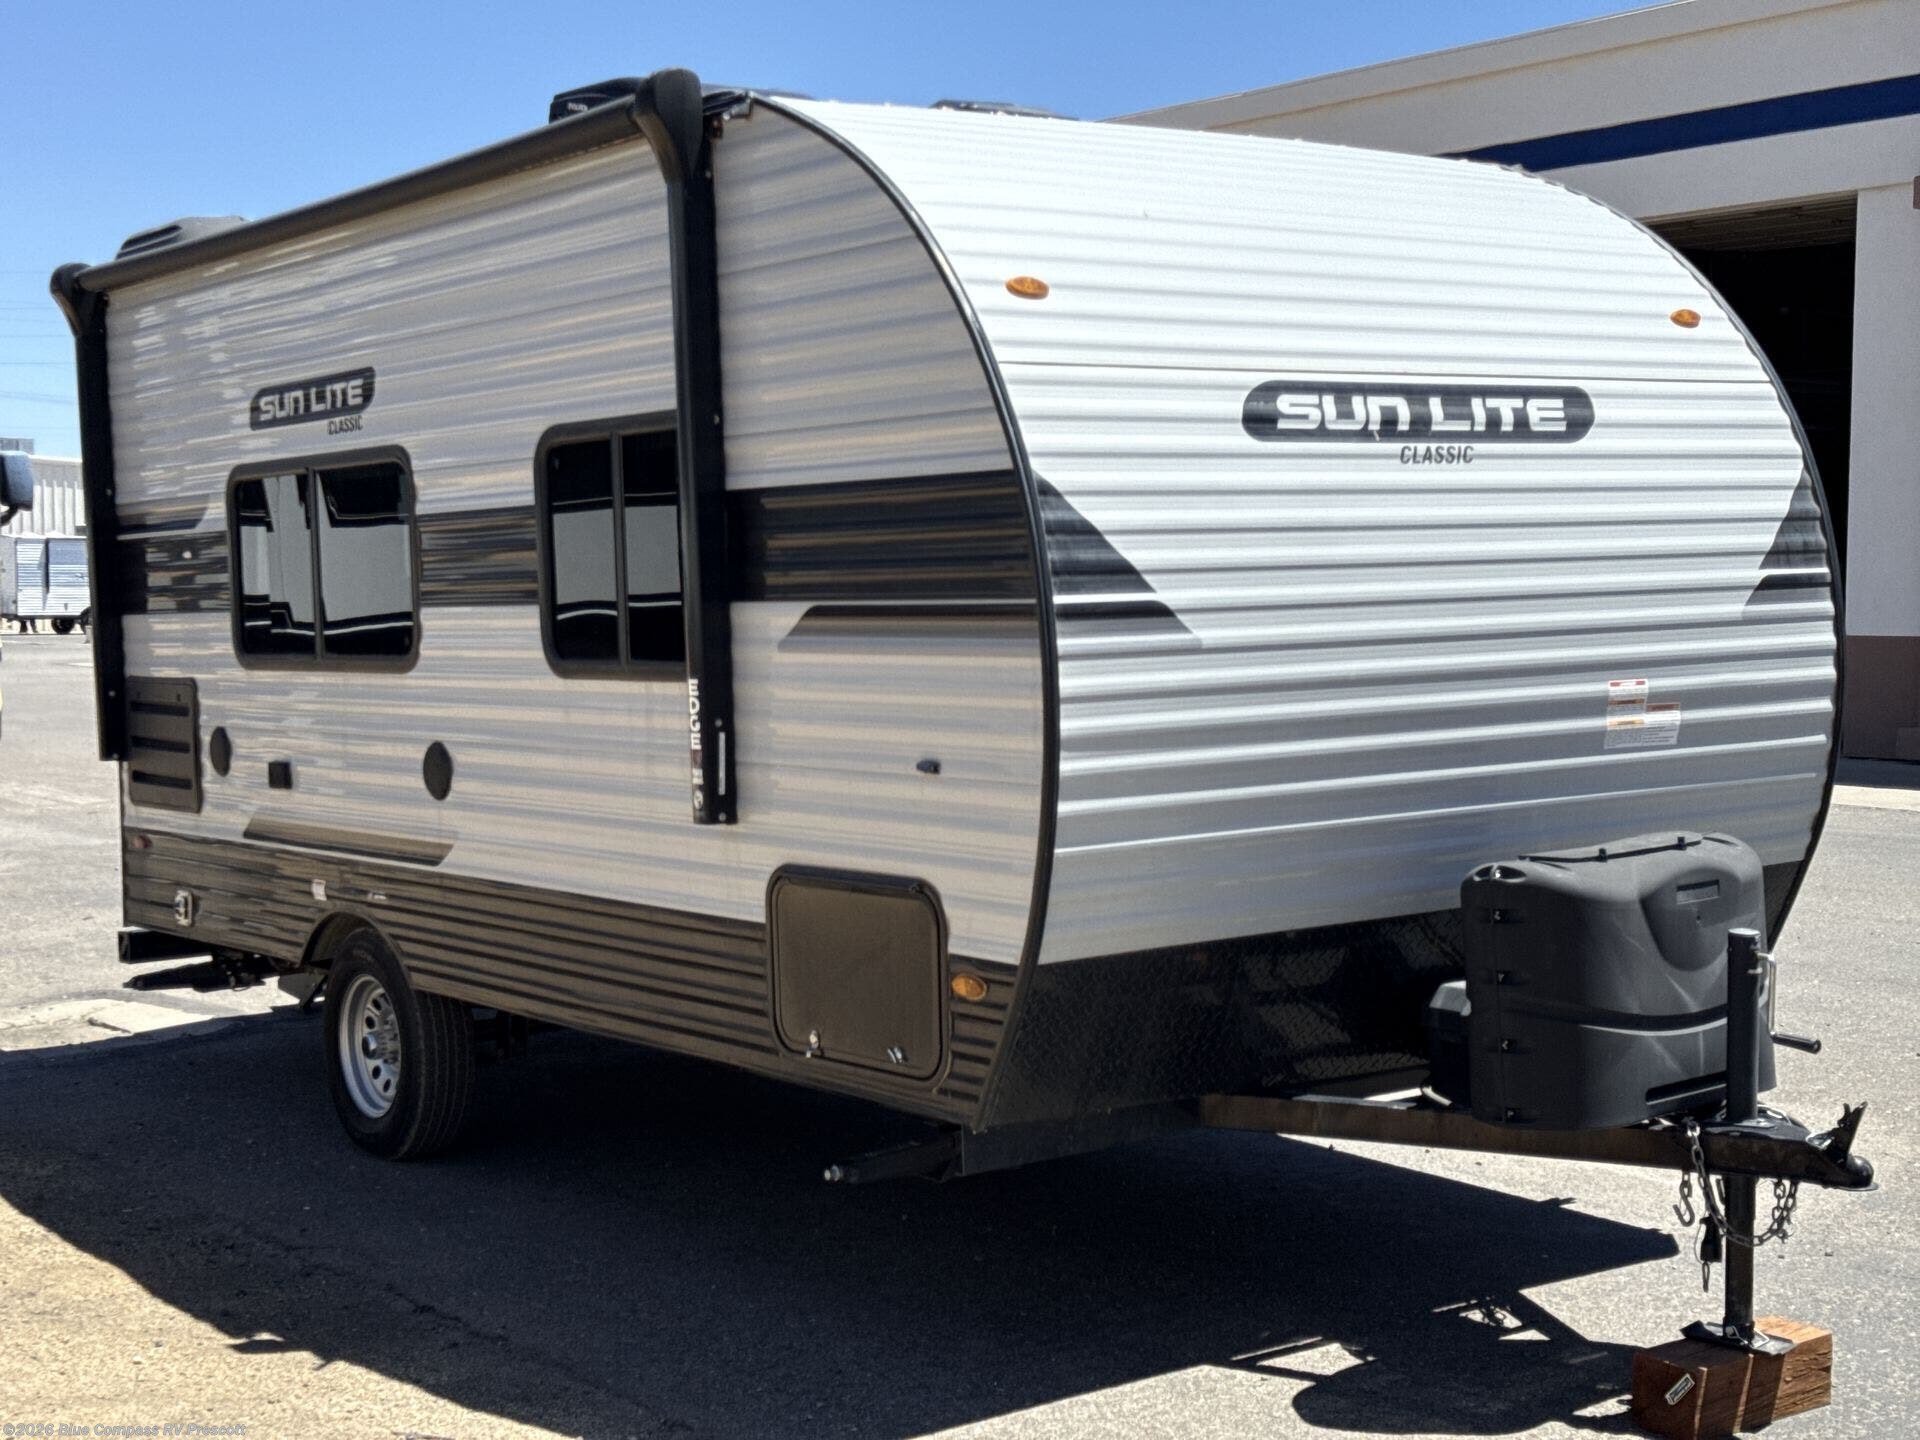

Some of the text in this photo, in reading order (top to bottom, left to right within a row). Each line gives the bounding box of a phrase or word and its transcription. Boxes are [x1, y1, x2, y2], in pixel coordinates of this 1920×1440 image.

[309, 378, 364, 412] LITE
[327, 415, 364, 435] CLASSIC
[1276, 393, 1568, 432] SUN LITE
[1399, 445, 1475, 465] CLASSIC
